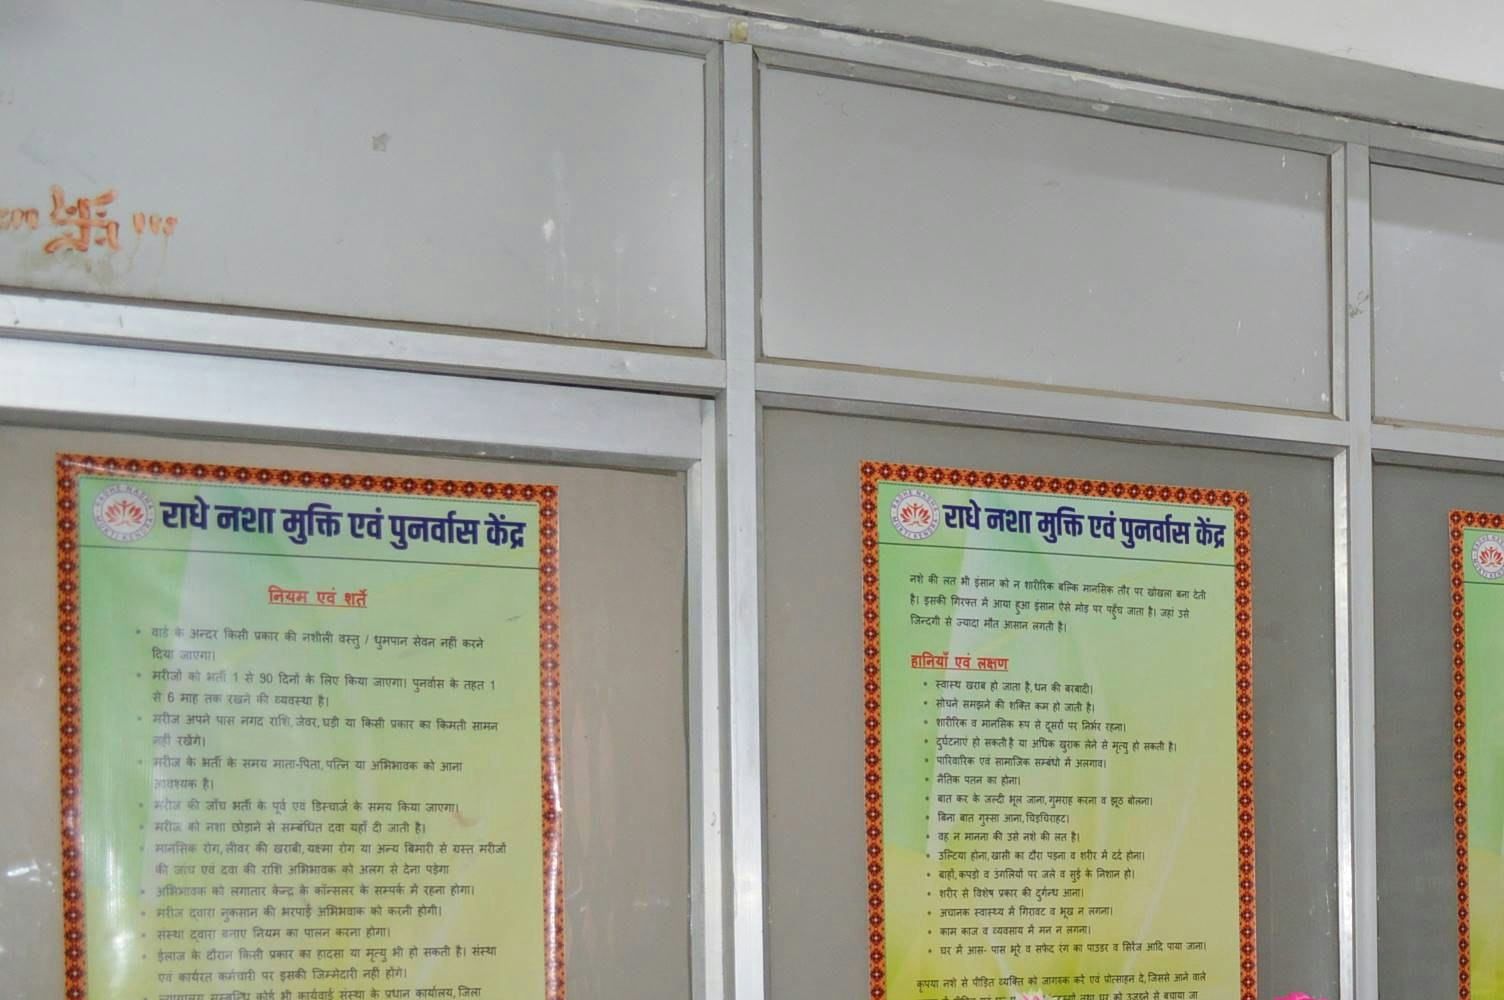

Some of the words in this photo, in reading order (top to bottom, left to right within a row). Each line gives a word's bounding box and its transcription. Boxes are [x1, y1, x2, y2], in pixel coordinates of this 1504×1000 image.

[159, 495, 210, 530] राधे
[214, 505, 276, 533] नशा
[280, 502, 343, 545] मुक्ति
[347, 507, 384, 539] एवं
[388, 510, 480, 550] पुनर्वास
[483, 512, 526, 549] केंद्र
[942, 498, 981, 530] राधे
[984, 507, 1032, 533] नशा
[1035, 505, 1085, 543] मुक्ति
[1087, 510, 1117, 539] एवं
[1119, 514, 1191, 549] पुनर्वास
[1193, 517, 1226, 548] केंद्र
[267, 584, 309, 604] नियम
[315, 590, 337, 605] एवं
[911, 651, 948, 668] हानियाँ
[954, 655, 972, 670] एवं
[976, 656, 1009, 671] लक्षण
[936, 772, 960, 784] नैतिक
[963, 775, 983, 784] पतन
[986, 776, 997, 784] का
